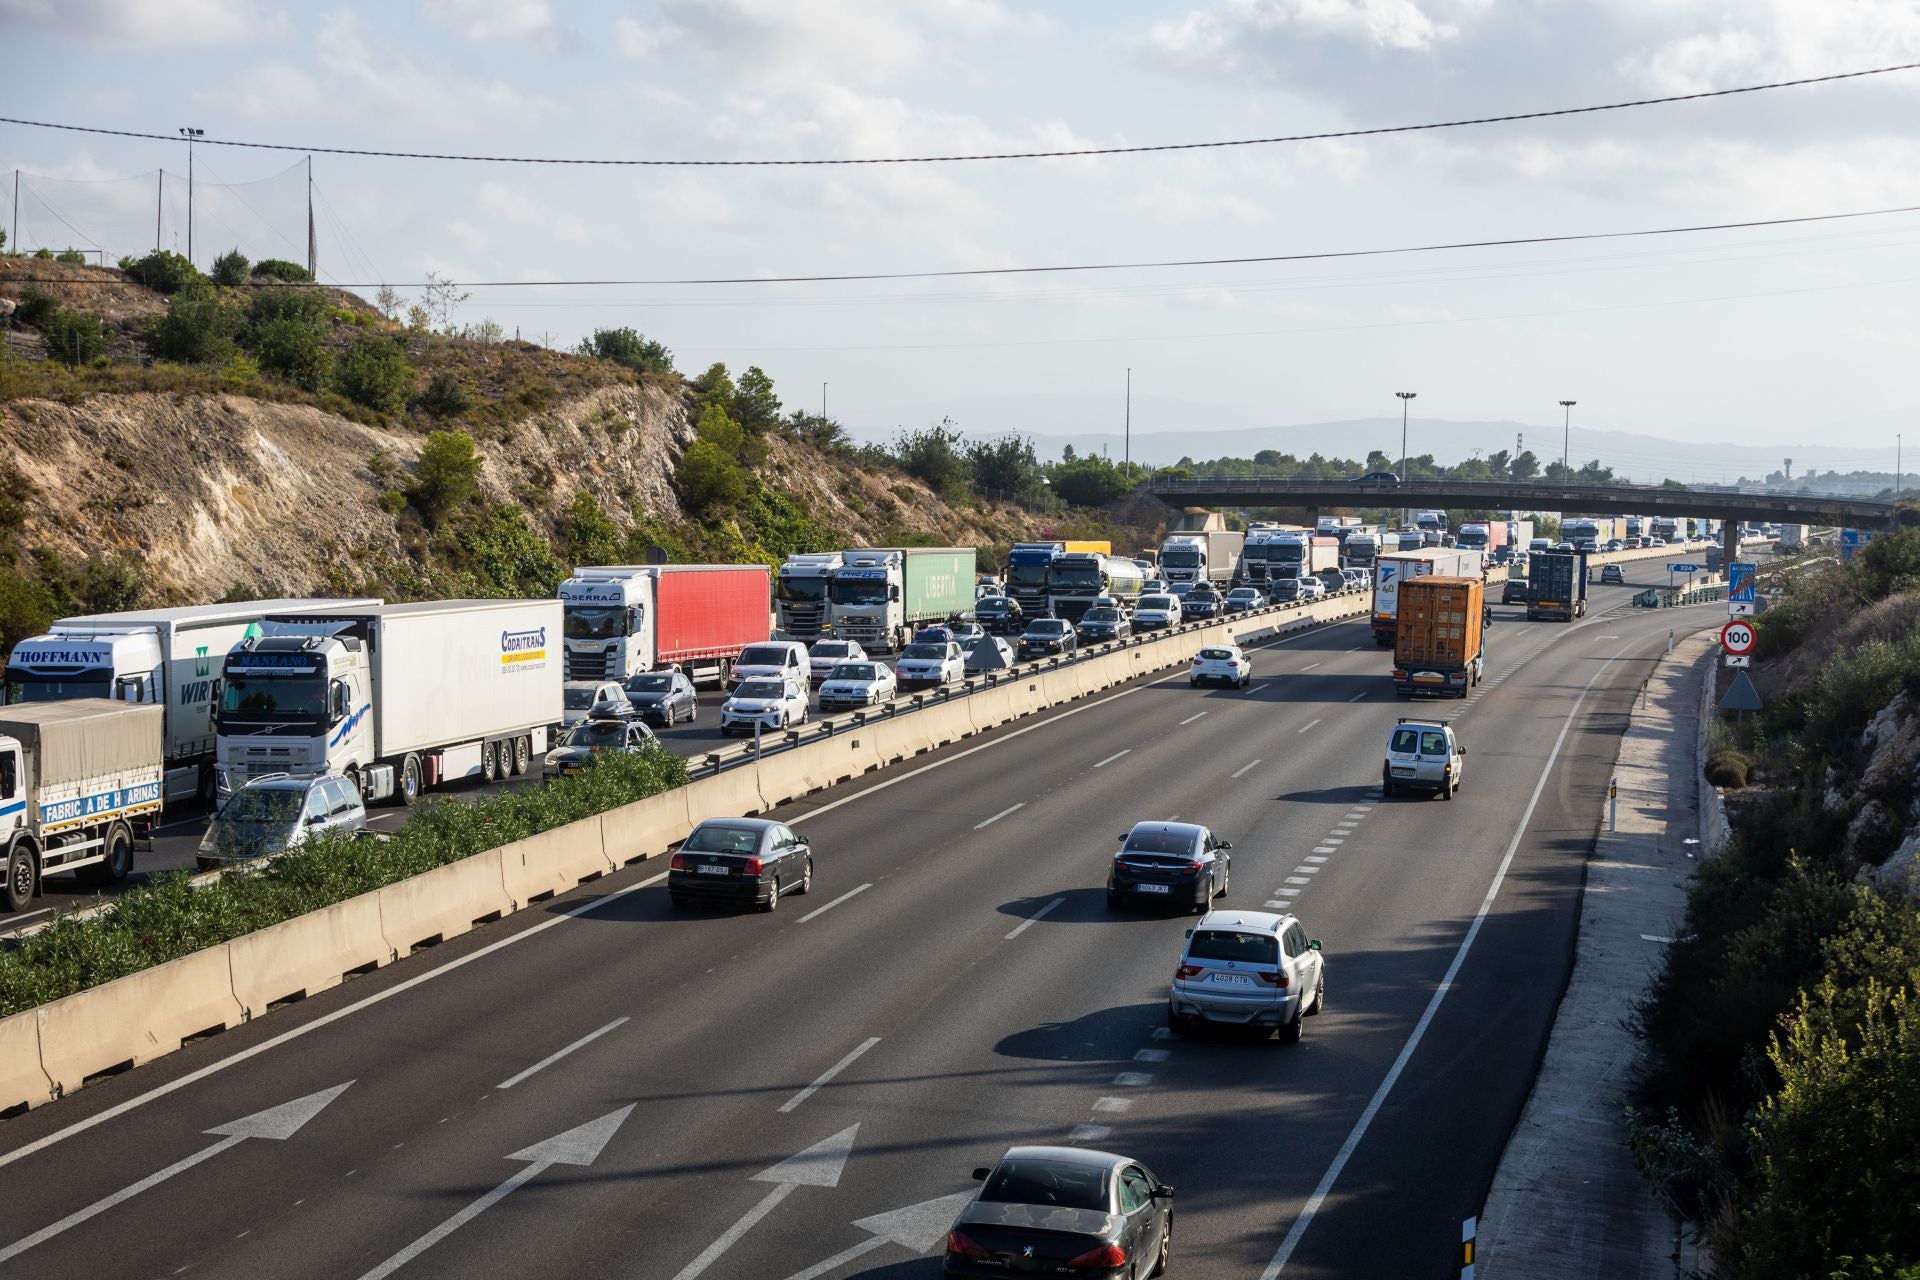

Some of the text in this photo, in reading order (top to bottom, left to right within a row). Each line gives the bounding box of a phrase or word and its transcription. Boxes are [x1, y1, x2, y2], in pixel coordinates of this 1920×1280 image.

[1727, 632, 1749, 643] 100
[20, 651, 102, 662] HOFFMANN
[240, 655, 308, 666] MANZANO
[97, 794, 110, 810] DE
